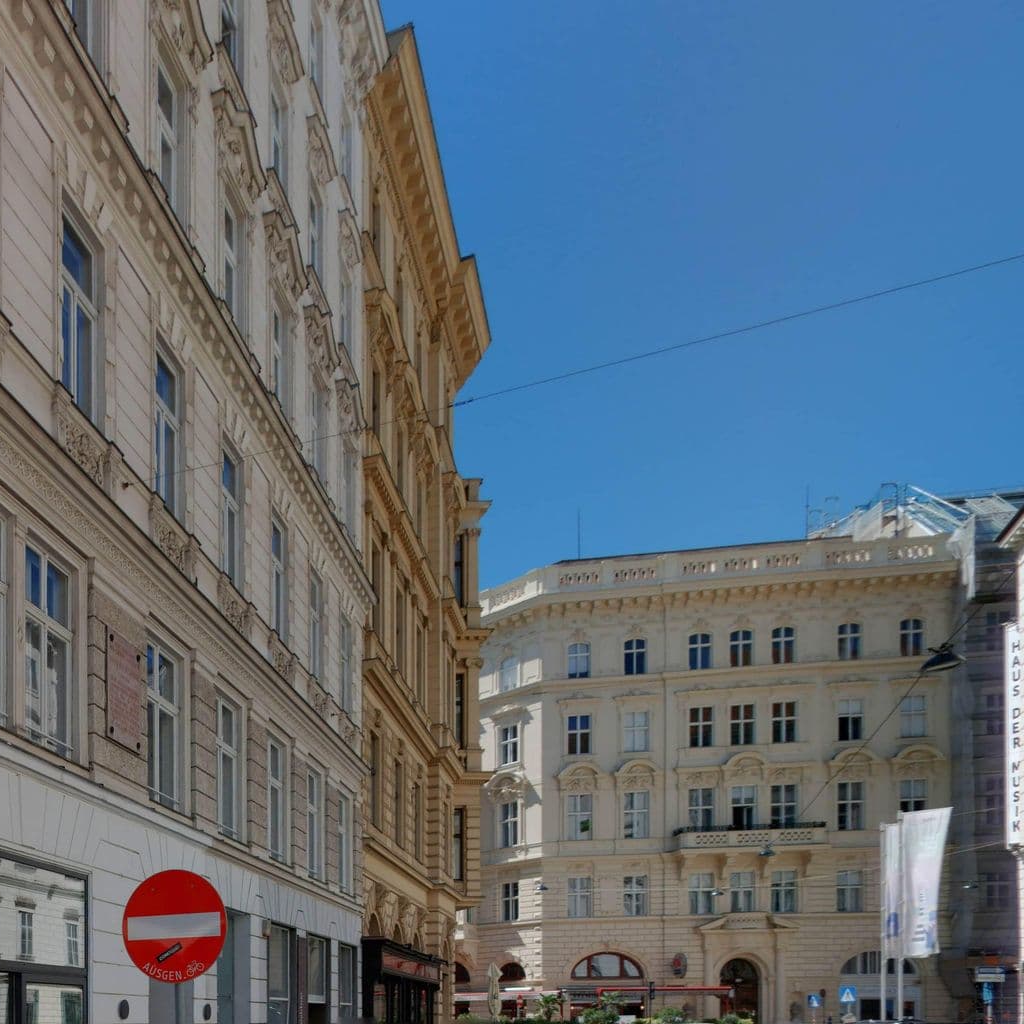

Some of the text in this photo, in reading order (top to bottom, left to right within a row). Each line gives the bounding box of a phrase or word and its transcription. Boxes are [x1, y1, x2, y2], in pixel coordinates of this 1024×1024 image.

[1011, 640, 1021, 833] HAUS DER MUSIK
